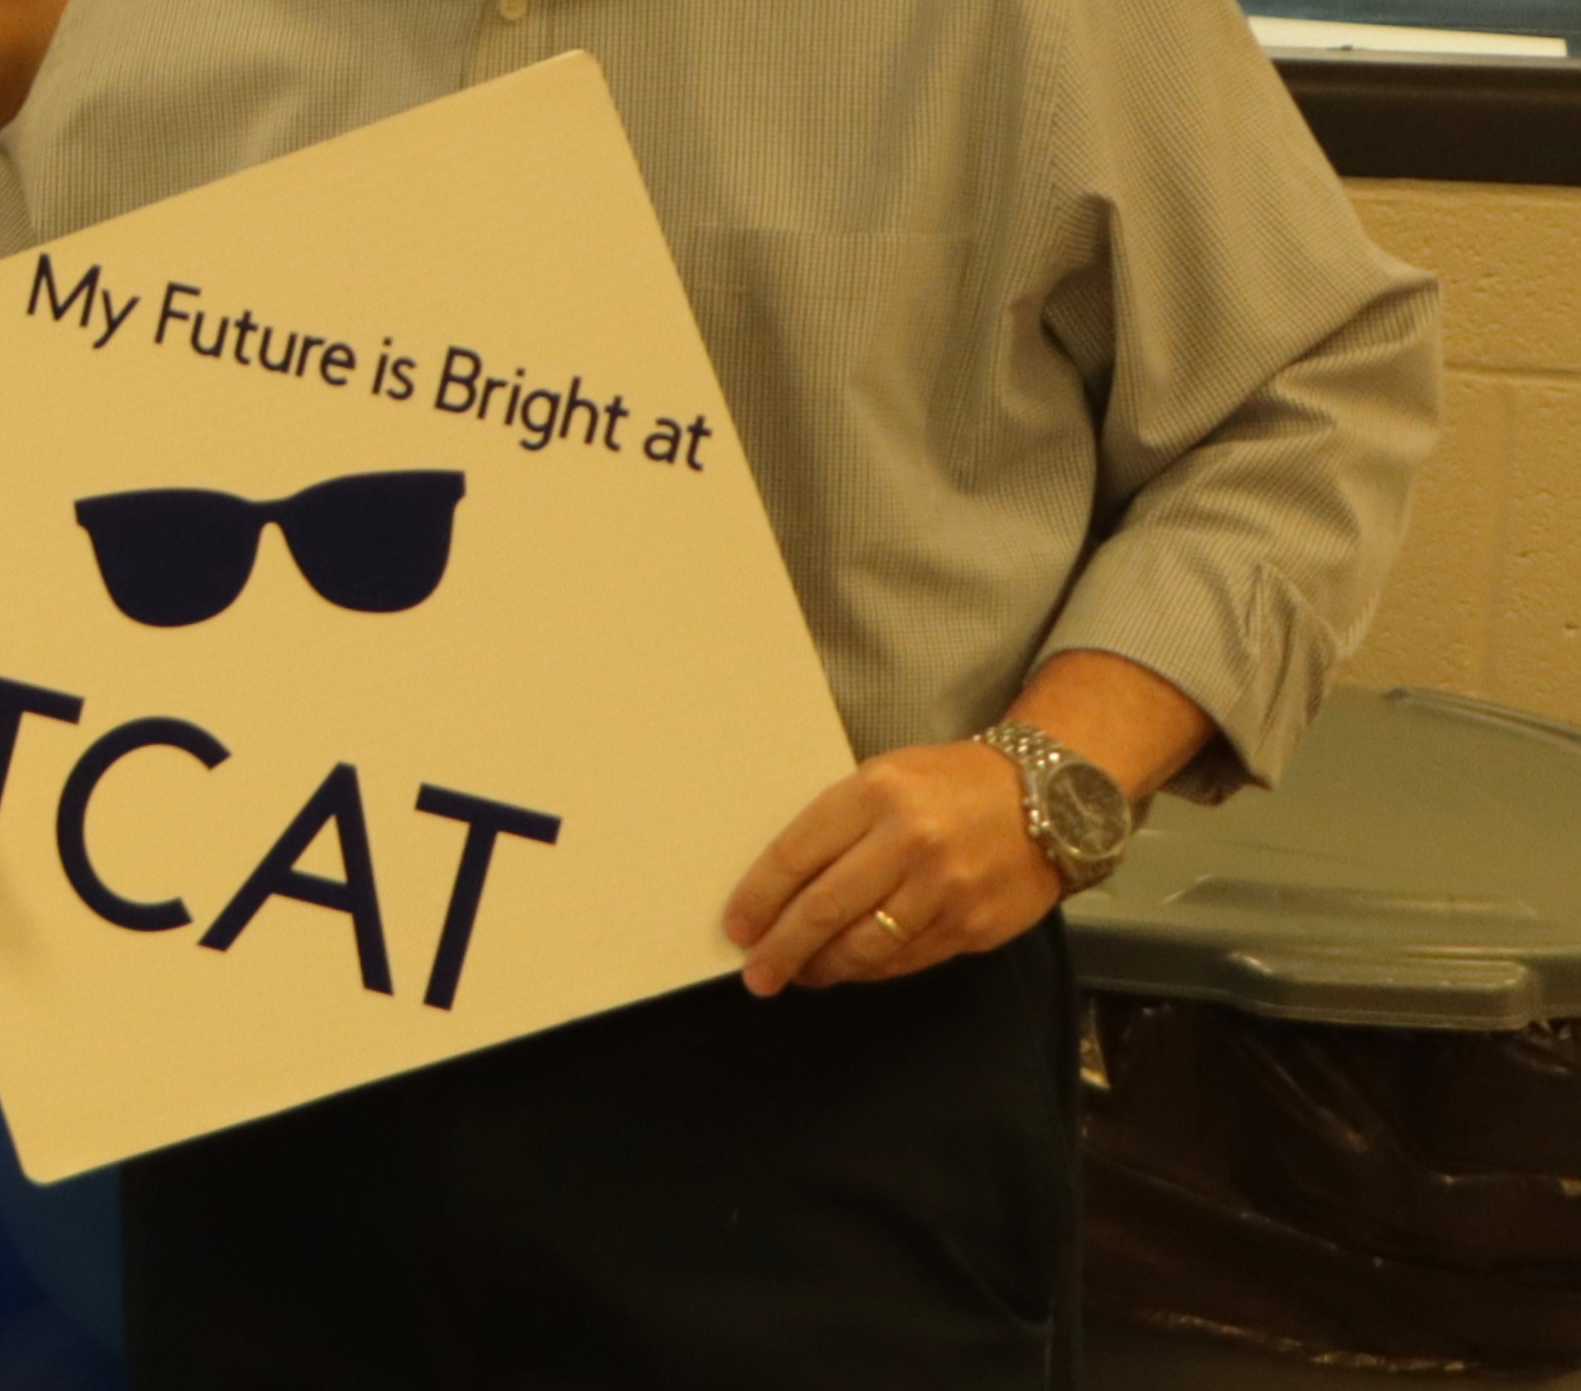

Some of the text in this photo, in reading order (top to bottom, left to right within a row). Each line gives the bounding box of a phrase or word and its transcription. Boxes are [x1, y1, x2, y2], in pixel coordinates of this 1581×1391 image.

[26, 252, 713, 472] My Future is Bright at
